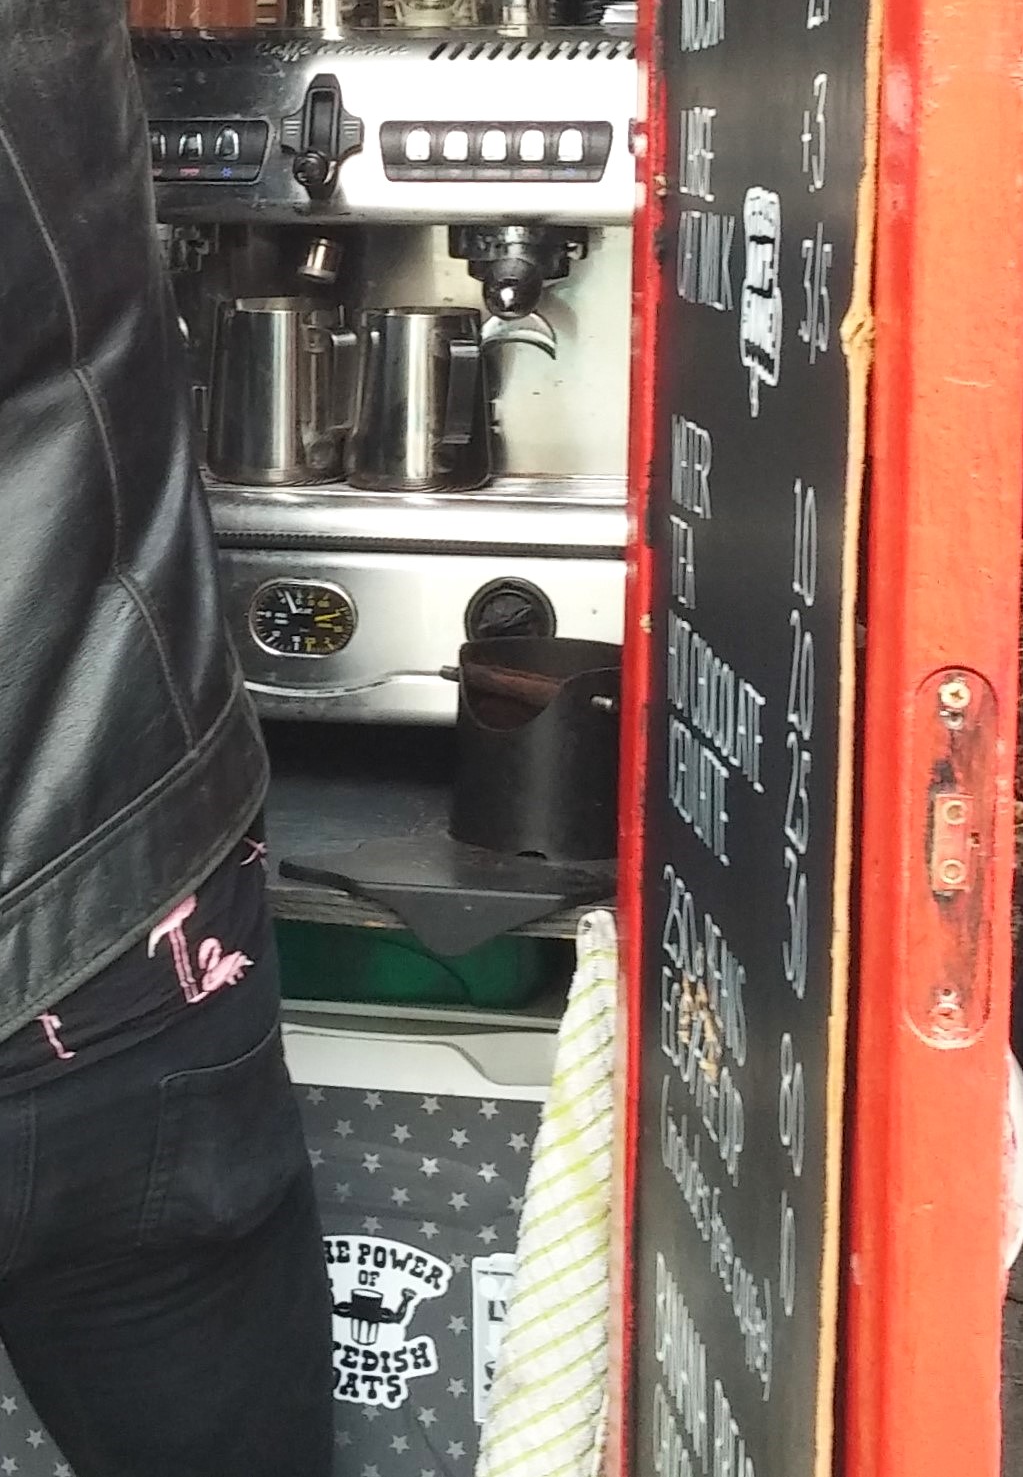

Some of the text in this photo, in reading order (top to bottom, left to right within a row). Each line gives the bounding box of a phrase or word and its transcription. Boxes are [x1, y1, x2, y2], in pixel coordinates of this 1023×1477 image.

[680, 107, 716, 201] LARGE
[699, 212, 735, 311] MILK
[672, 414, 711, 520] WATER
[670, 514, 695, 609] TEA
[668, 609, 691, 717] HOT
[691, 631, 765, 792] CHOCOLATE
[694, 740, 730, 866] LATTE
[324, 1240, 444, 1290] HE POWER
[358, 1269, 381, 1287] OF
[333, 1340, 432, 1374] EDISH
